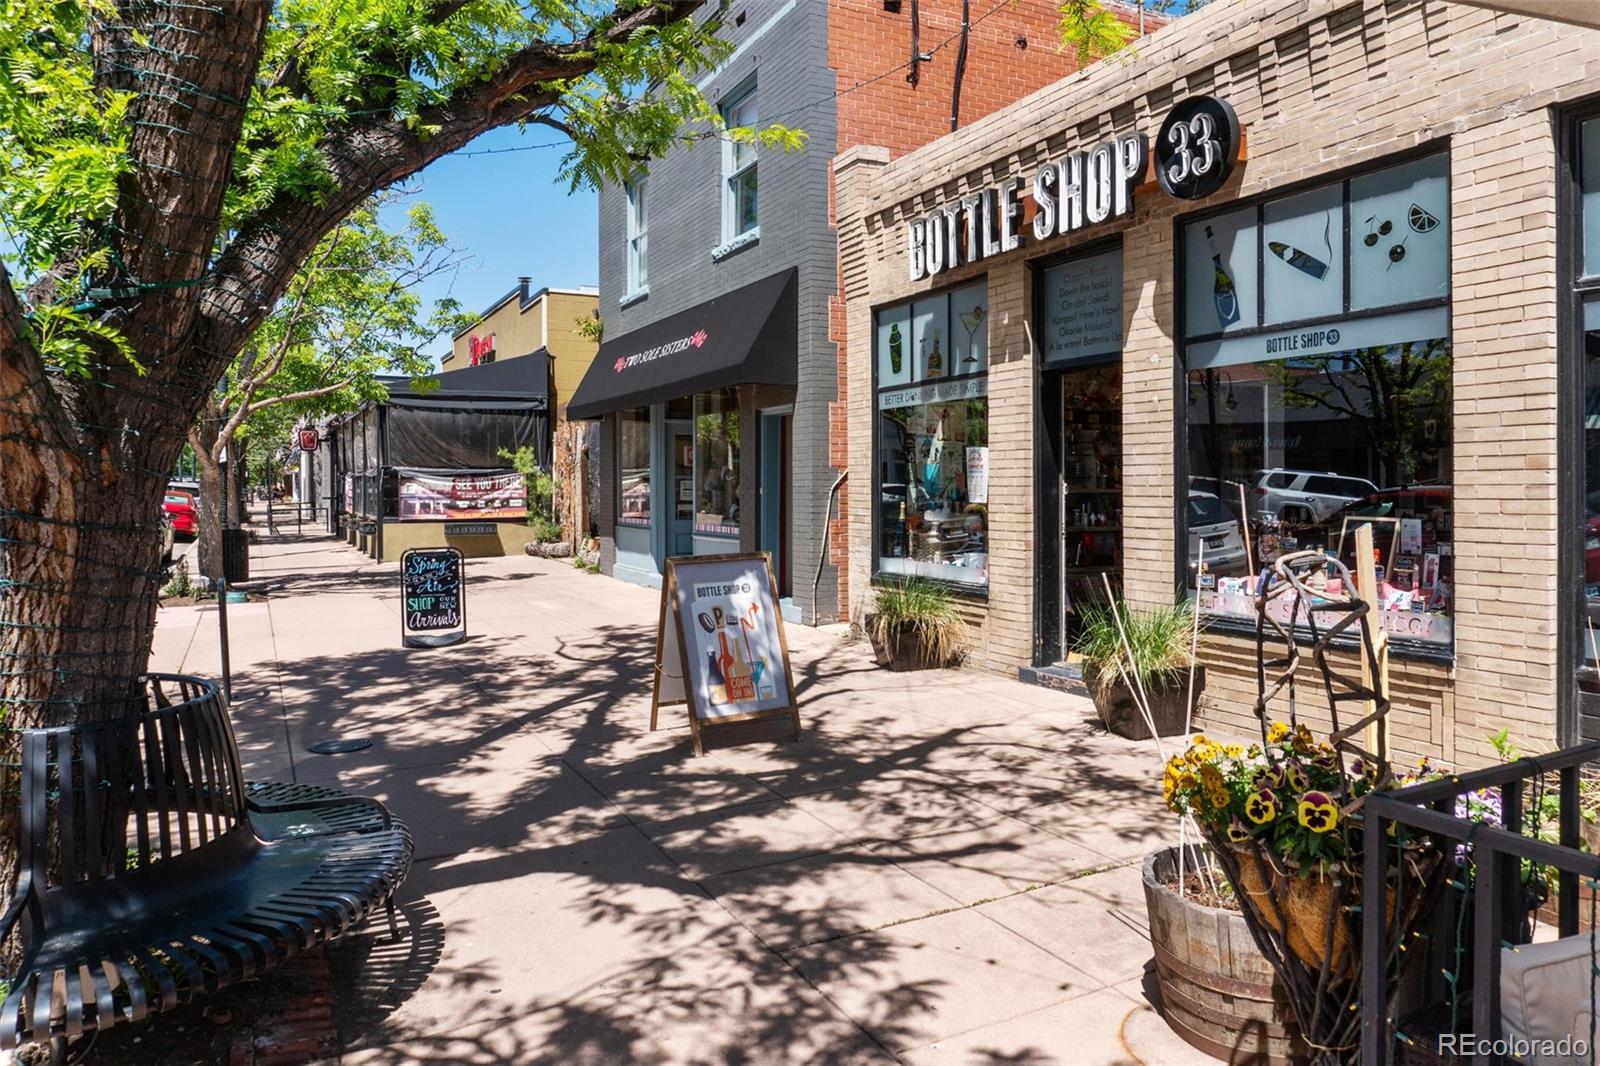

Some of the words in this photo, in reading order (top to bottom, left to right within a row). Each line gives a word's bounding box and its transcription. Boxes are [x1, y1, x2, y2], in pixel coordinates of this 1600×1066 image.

[908, 178, 1025, 282] BOTTLE
[1033, 131, 1148, 241] SHOP
[1167, 112, 1223, 185] 33
[1266, 333, 1299, 354] BOTTLE
[1301, 330, 1326, 349] SHOP
[624, 352, 642, 369] TWO
[640, 347, 661, 364] SOLE
[659, 336, 694, 358] SISTERS
[884, 393, 904, 407] BETTER
[455, 478, 473, 490] SEE
[475, 478, 492, 490] YOU
[408, 556, 451, 575] Spring
[416, 579, 450, 593] Air
[696, 585, 722, 598] BOTTLE
[722, 583, 740, 596] SHOP
[407, 596, 435, 611] SHOP
[439, 602, 457, 610] NEW
[409, 609, 461, 628] Arrivals
[730, 675, 753, 689] COME
